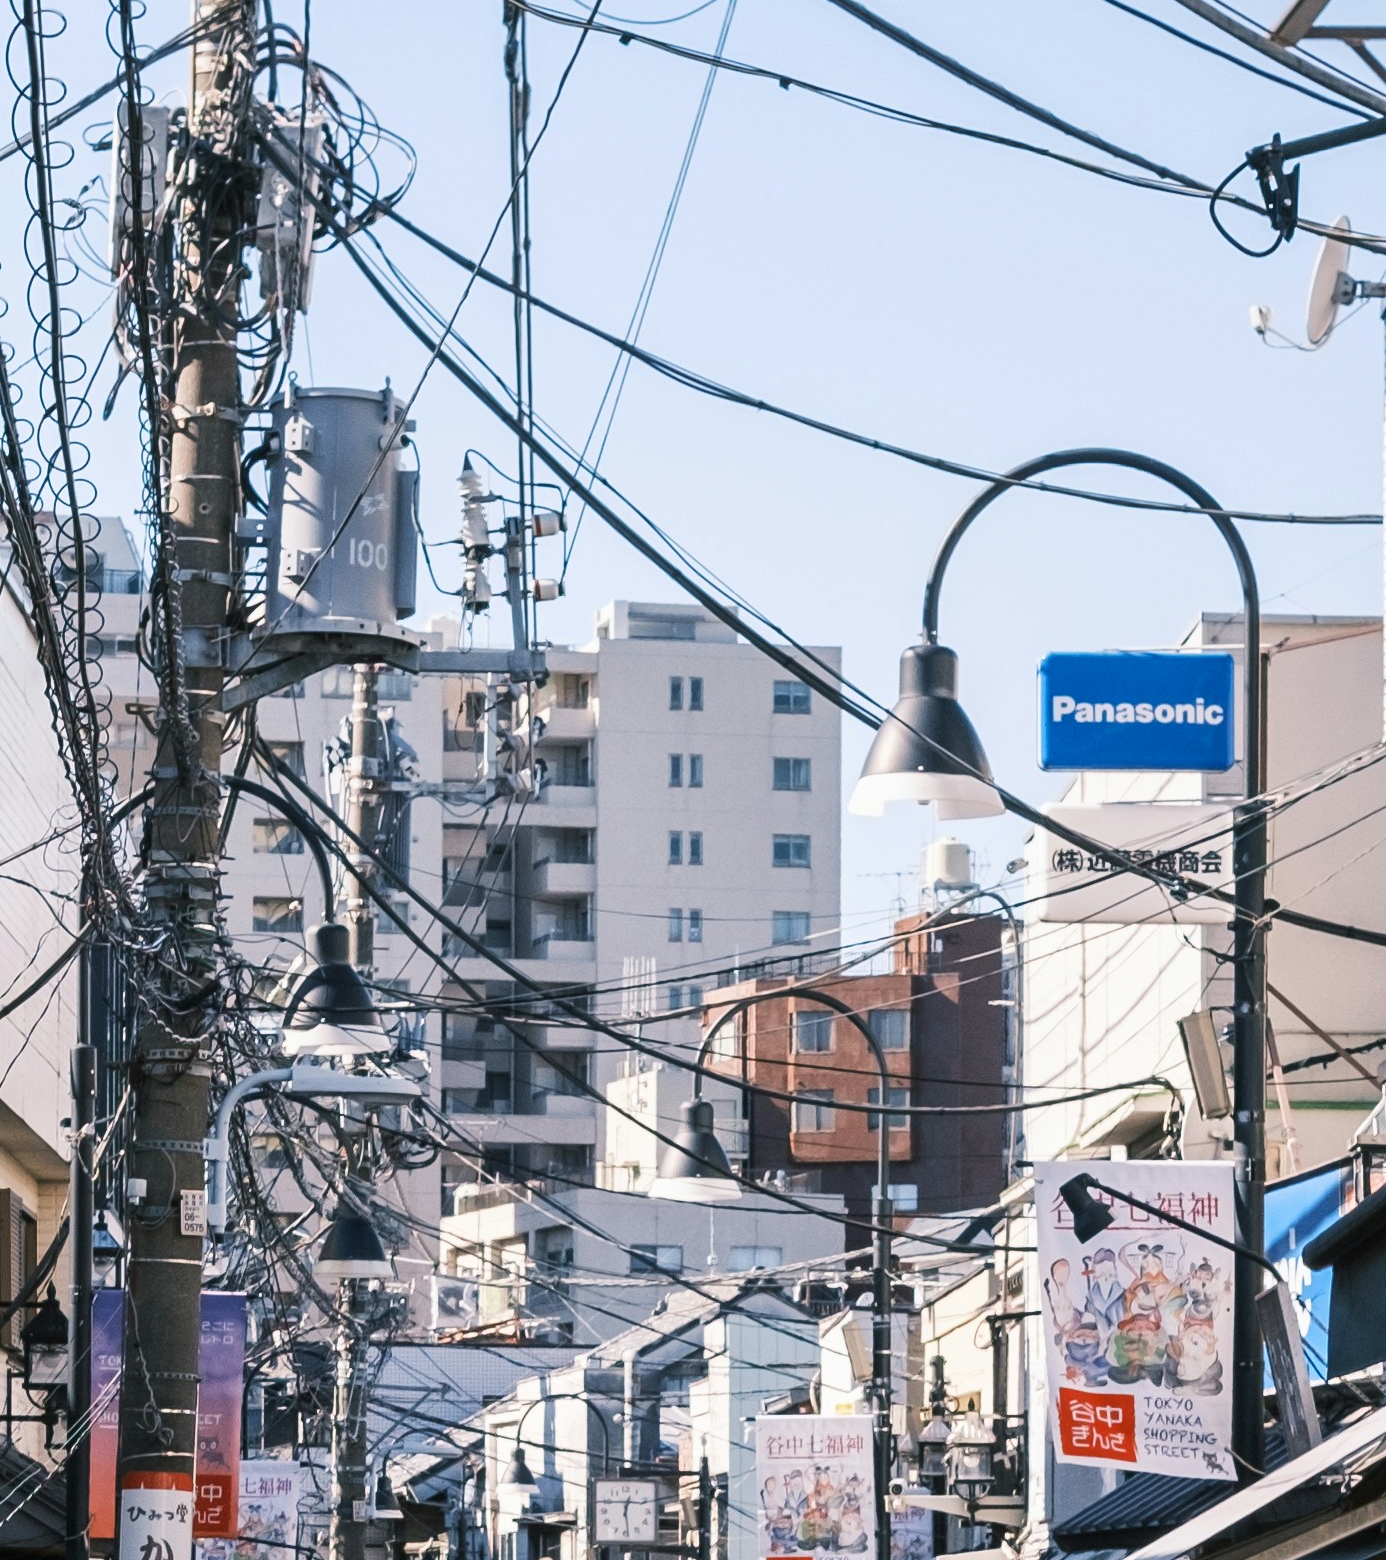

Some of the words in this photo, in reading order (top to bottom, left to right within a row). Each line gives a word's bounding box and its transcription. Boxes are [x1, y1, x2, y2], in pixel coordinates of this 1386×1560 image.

[1052, 695, 1224, 726] Panasonic
[1144, 1397, 1194, 1410] TOKYO
[1069, 1400, 1123, 1427] 谷中
[1144, 1411, 1202, 1427] YANAKA
[766, 1434, 864, 1455] 谷中七福神
[1072, 1426, 1126, 1452] ぎんざ
[1144, 1427, 1217, 1445] SHOPPING
[1144, 1444, 1200, 1459] STREET
